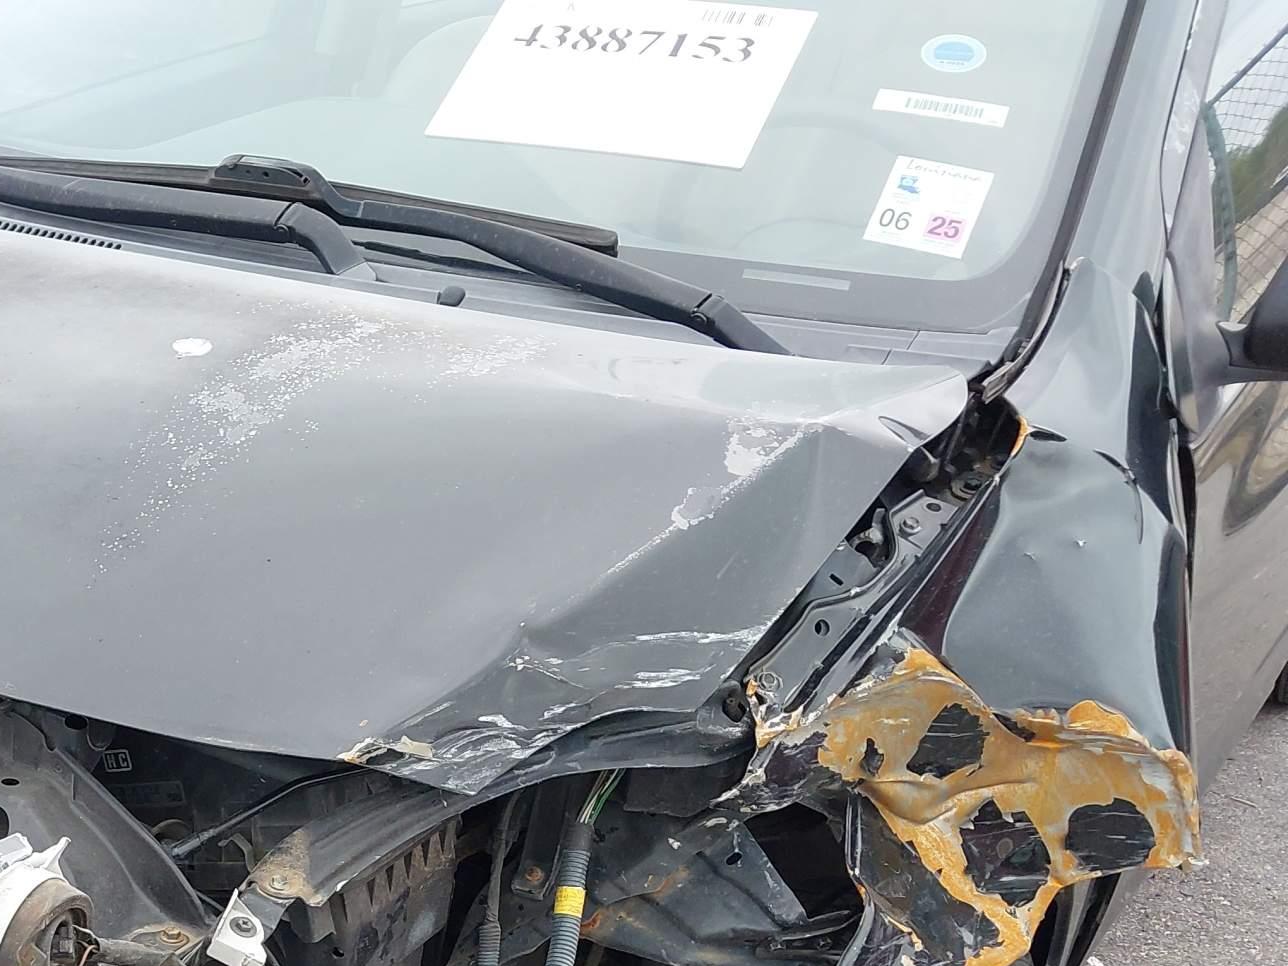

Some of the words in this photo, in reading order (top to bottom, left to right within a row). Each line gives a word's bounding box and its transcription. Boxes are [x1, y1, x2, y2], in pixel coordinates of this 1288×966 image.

[514, 23, 755, 63] 43887153
[879, 208, 912, 231] 06
[927, 216, 962, 239] 25
